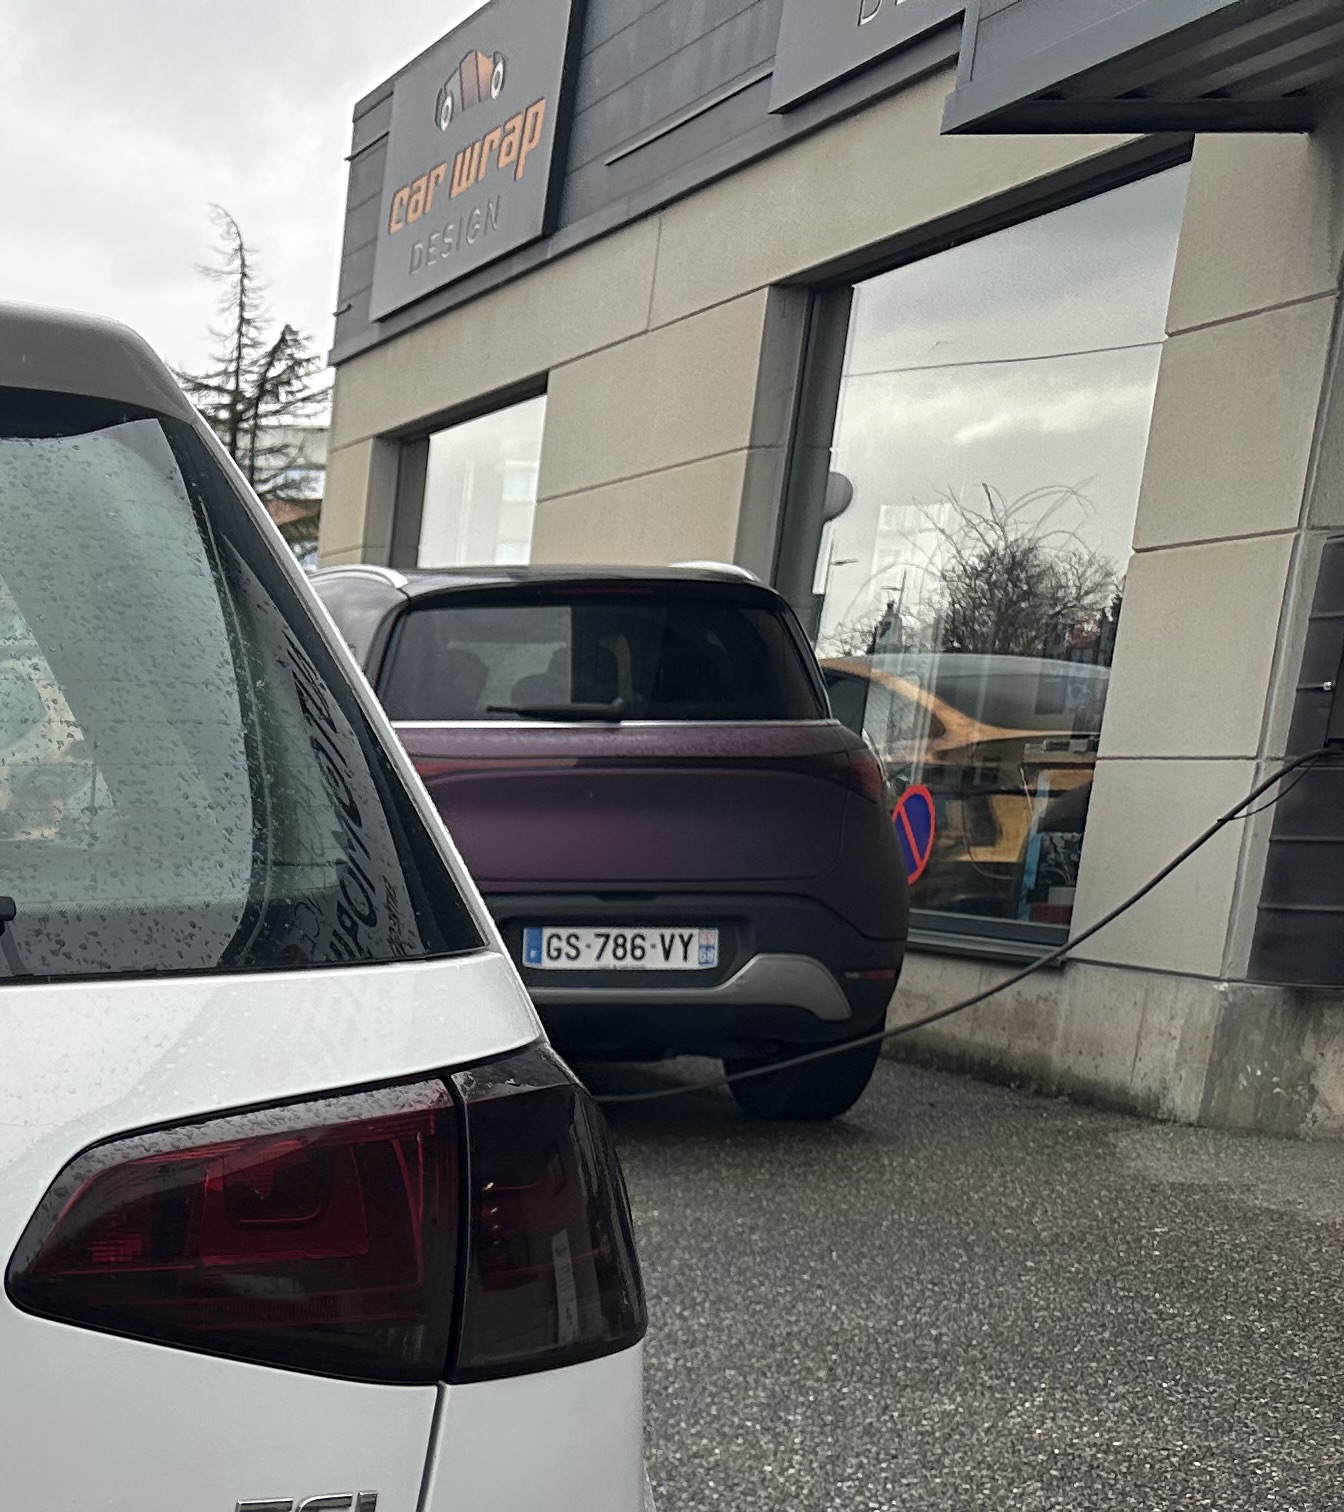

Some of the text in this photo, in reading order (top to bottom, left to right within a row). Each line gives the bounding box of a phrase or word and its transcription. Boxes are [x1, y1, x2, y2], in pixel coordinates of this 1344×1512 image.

[388, 96, 546, 235] car wrap
[409, 195, 501, 276] DESIGN
[545, 932, 694, 963] GS-786-VY
